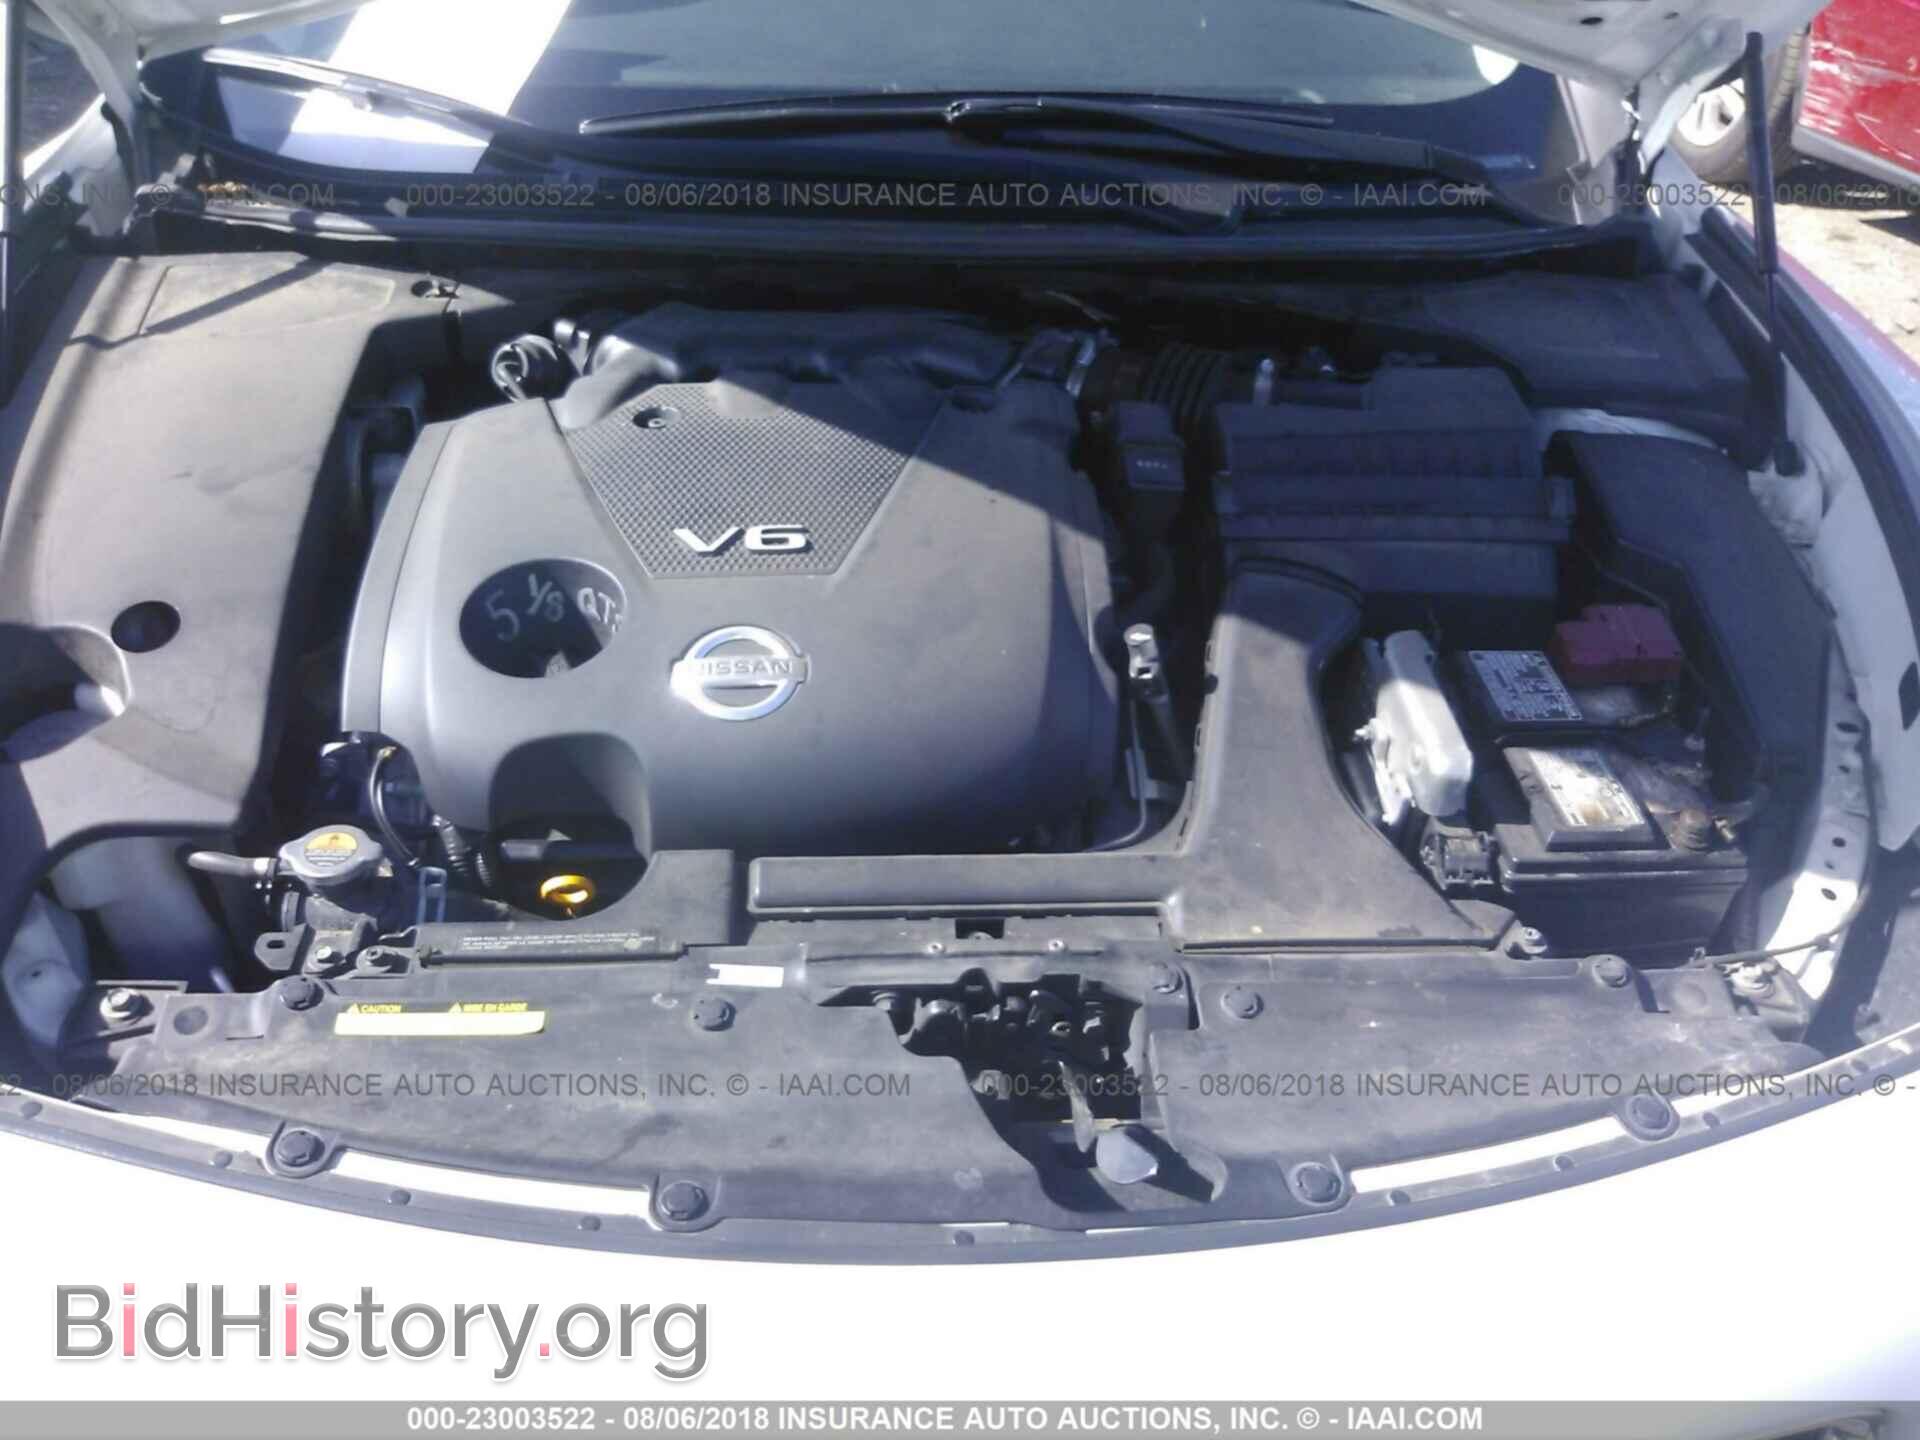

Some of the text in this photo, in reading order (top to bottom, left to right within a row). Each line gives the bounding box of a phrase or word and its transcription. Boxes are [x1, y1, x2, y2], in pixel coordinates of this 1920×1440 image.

[673, 523, 813, 557] V6
[485, 589, 520, 641] 5
[688, 660, 793, 675] ISSAN
